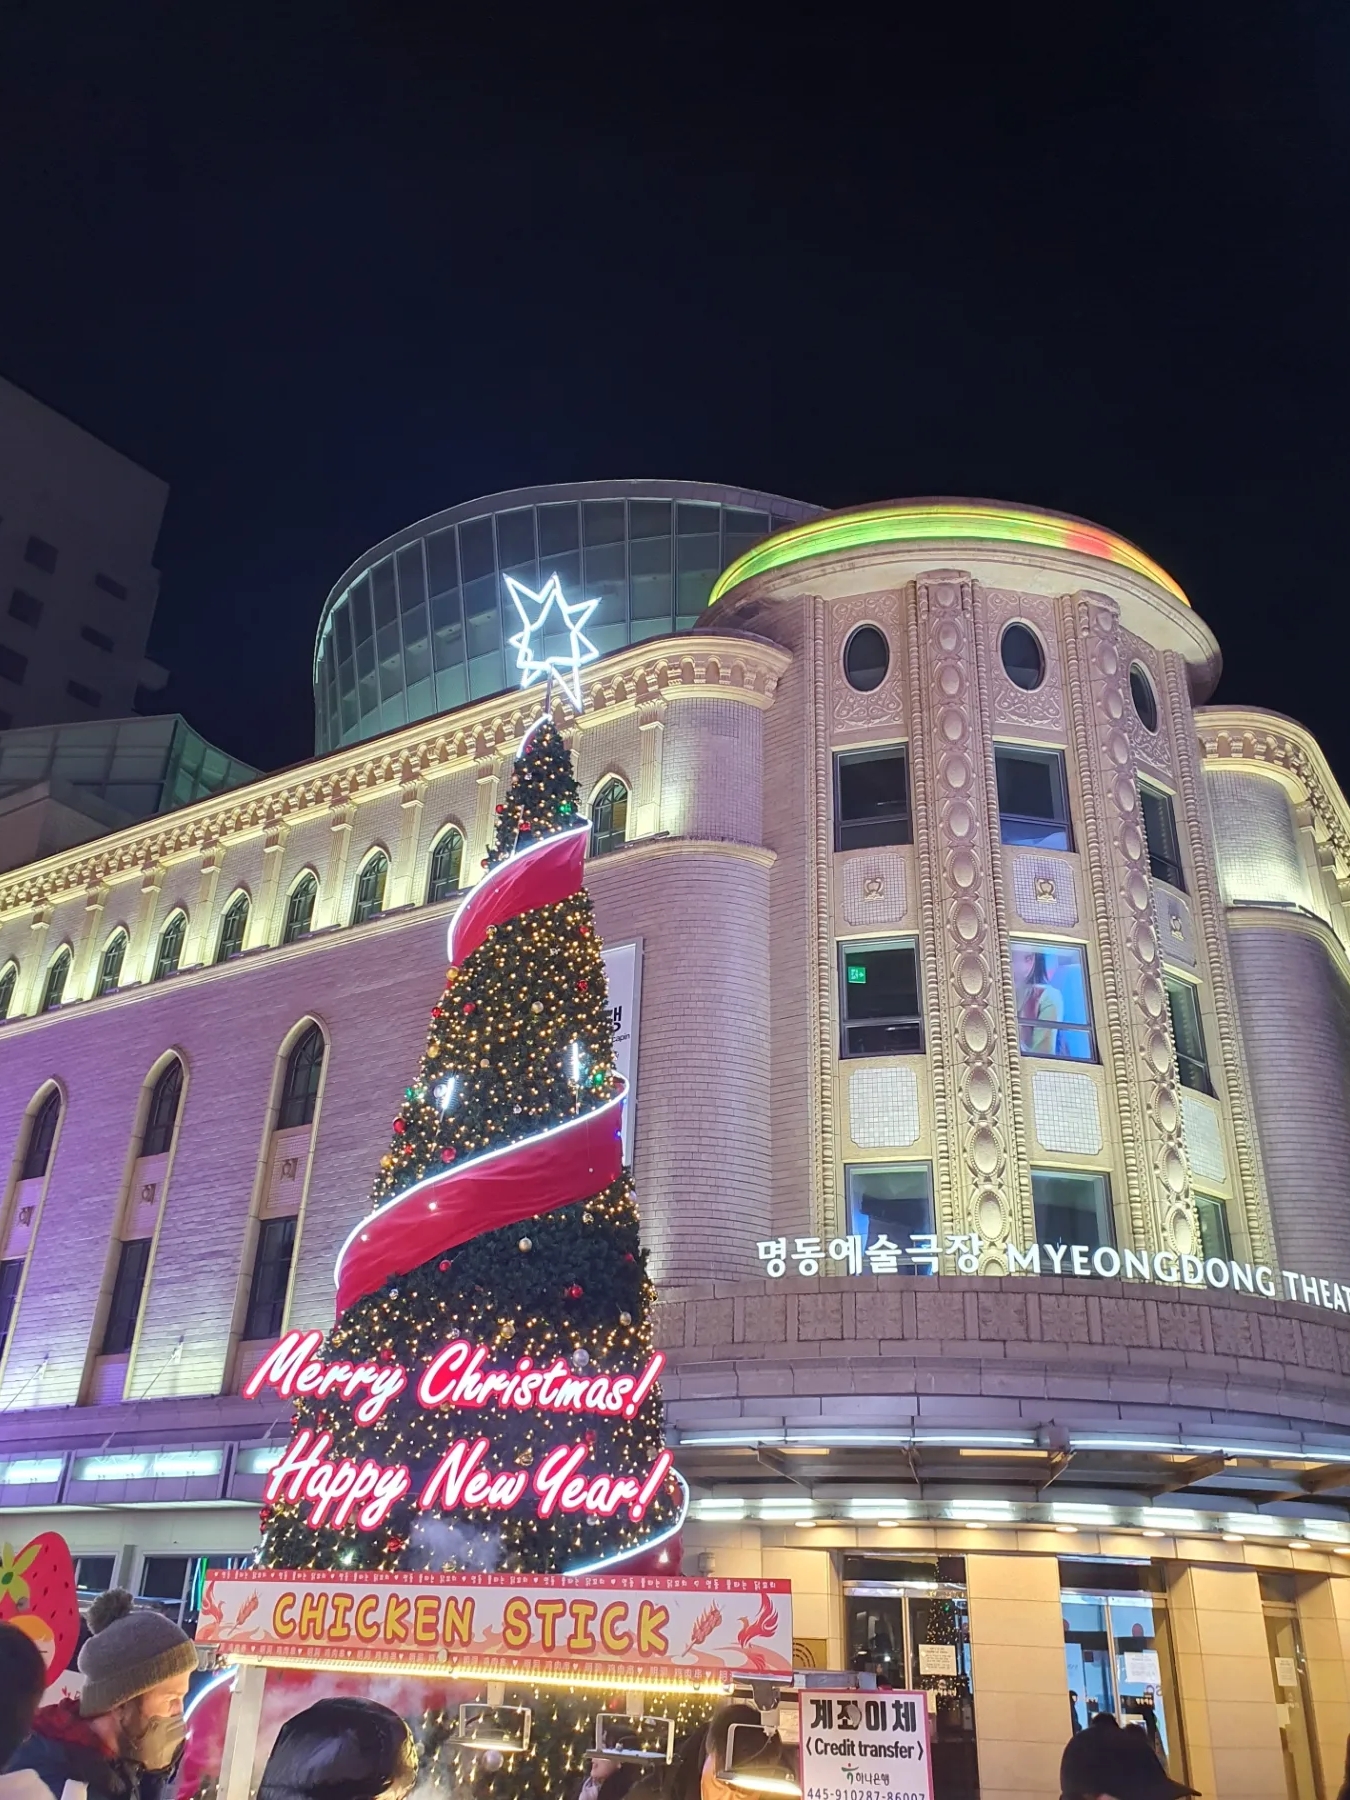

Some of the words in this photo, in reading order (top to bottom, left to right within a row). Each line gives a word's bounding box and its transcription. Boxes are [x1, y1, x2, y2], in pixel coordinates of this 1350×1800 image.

[756, 1233, 984, 1278] 명동예술극장
[1007, 1241, 1276, 1297] MYEONGDONG
[245, 1330, 406, 1426] Merry
[419, 1341, 665, 1420] Christmas!
[263, 1428, 411, 1532] Happy
[420, 1437, 530, 1512] New
[532, 1443, 674, 1524] Year!
[272, 1592, 475, 1647] CHICKEN
[500, 1595, 670, 1657] STICK
[810, 1699, 917, 1733] 계좌이체
